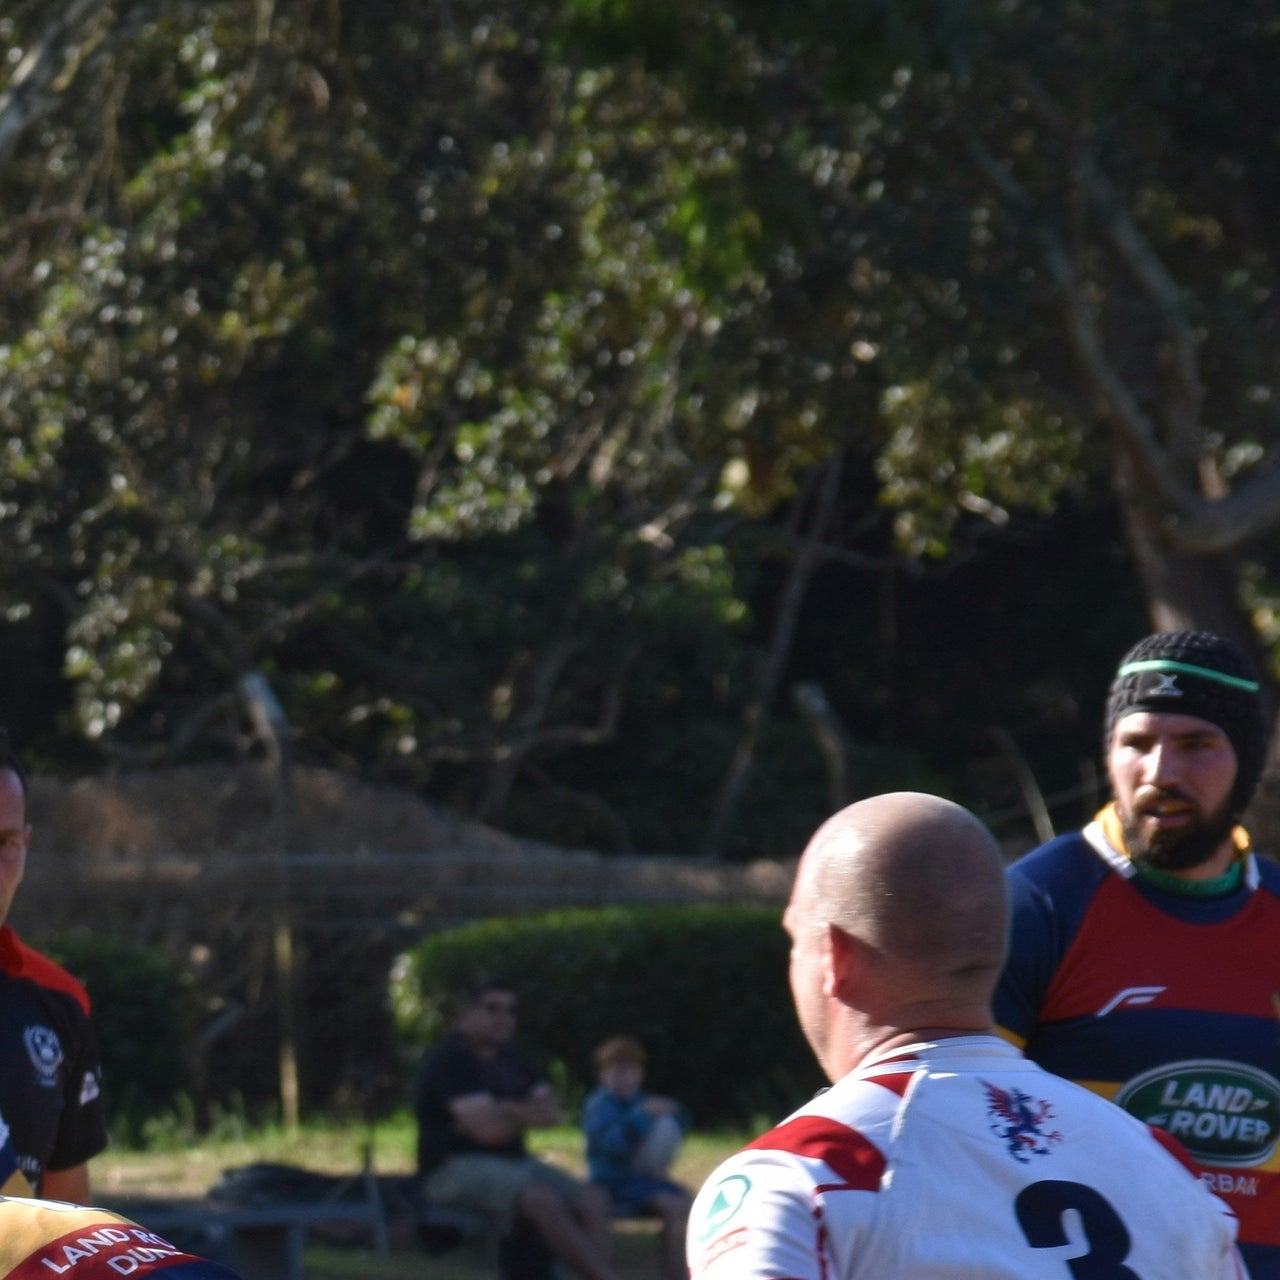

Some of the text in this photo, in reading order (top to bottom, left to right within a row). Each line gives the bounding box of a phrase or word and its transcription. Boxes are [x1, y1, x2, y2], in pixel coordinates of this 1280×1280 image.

[1160, 1080, 1254, 1113] LAND
[1168, 1110, 1271, 1143] ROVER
[41, 1228, 130, 1275] LAND
